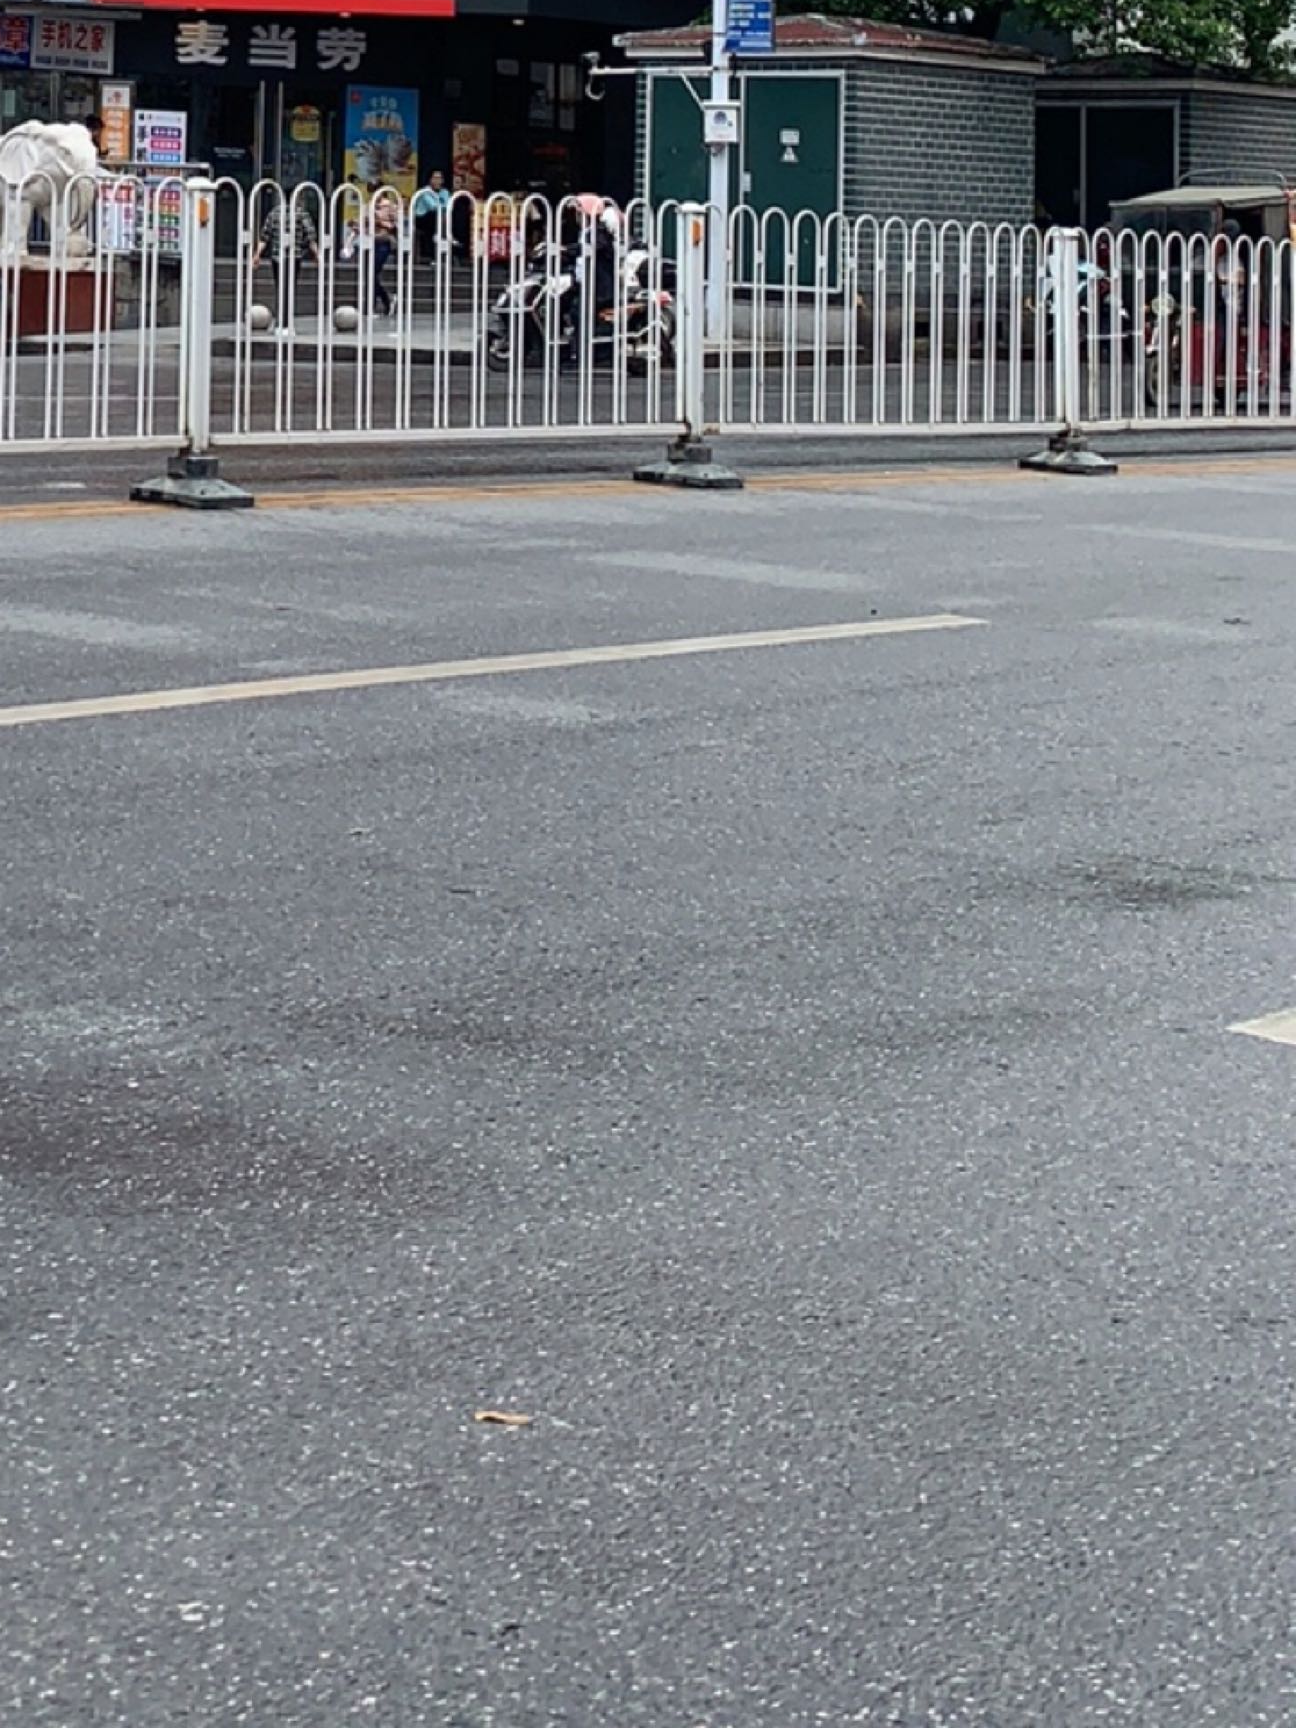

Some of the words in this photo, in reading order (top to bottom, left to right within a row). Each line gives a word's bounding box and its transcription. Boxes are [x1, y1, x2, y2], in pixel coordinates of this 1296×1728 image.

[40, 19, 107, 53] 手机之家
[174, 19, 368, 72] 麦当劳
